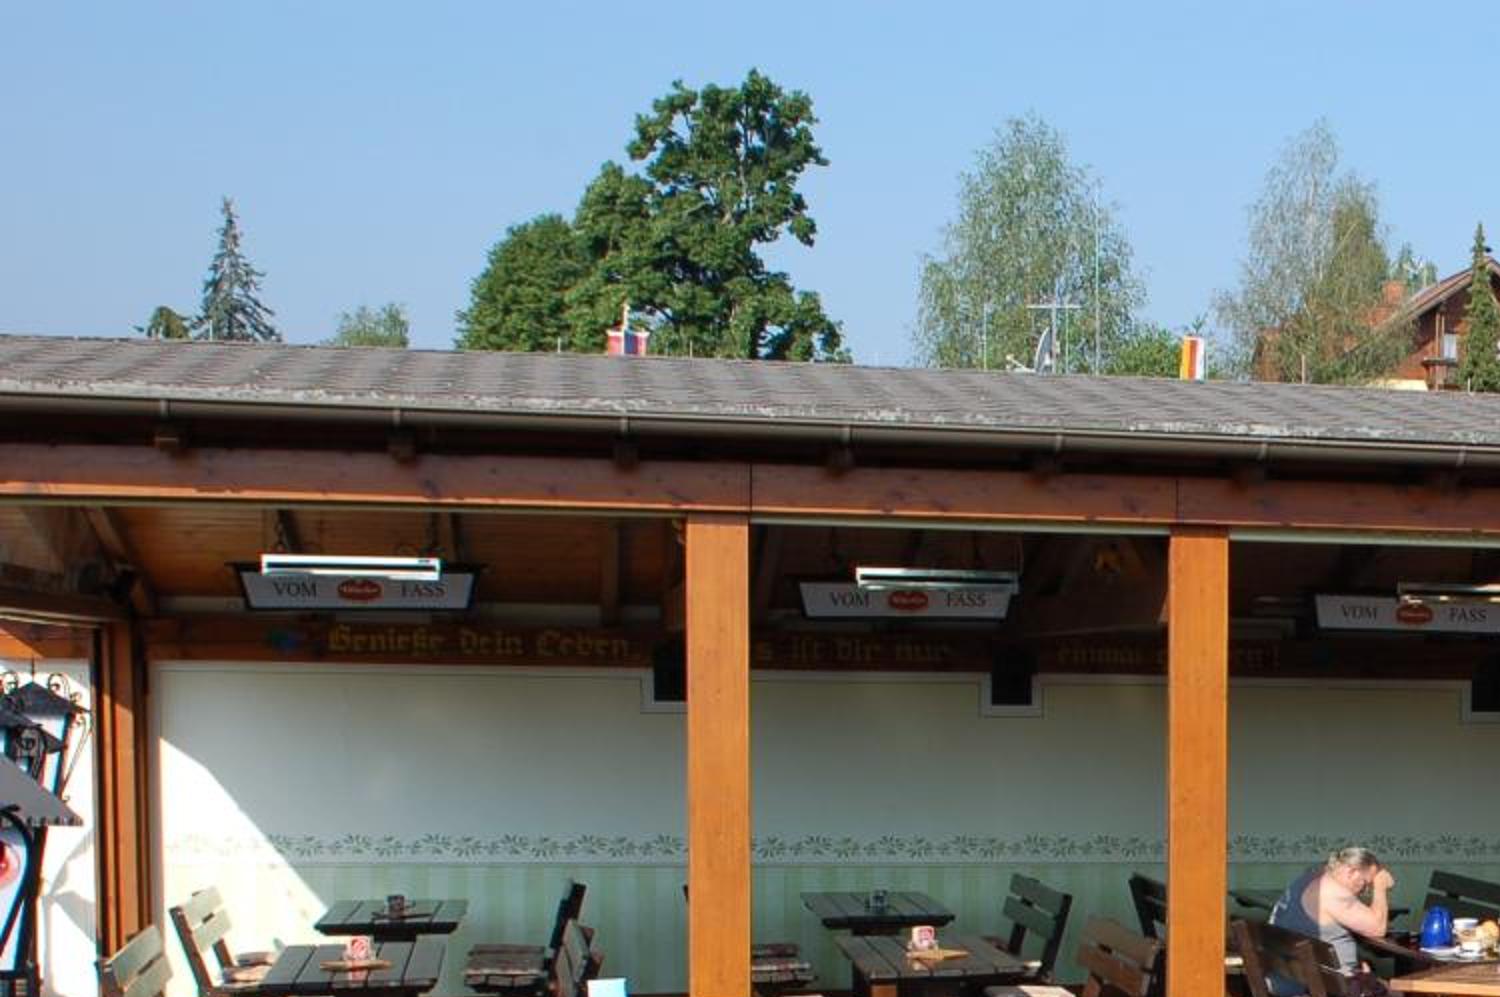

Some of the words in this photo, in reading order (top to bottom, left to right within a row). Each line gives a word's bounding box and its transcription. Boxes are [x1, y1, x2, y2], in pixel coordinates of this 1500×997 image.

[273, 582, 317, 598] VOM
[401, 583, 446, 598] FASS
[831, 591, 870, 607] VOM
[946, 591, 988, 607] FASS
[1341, 605, 1378, 620] VOM
[1448, 606, 1489, 623] FASS
